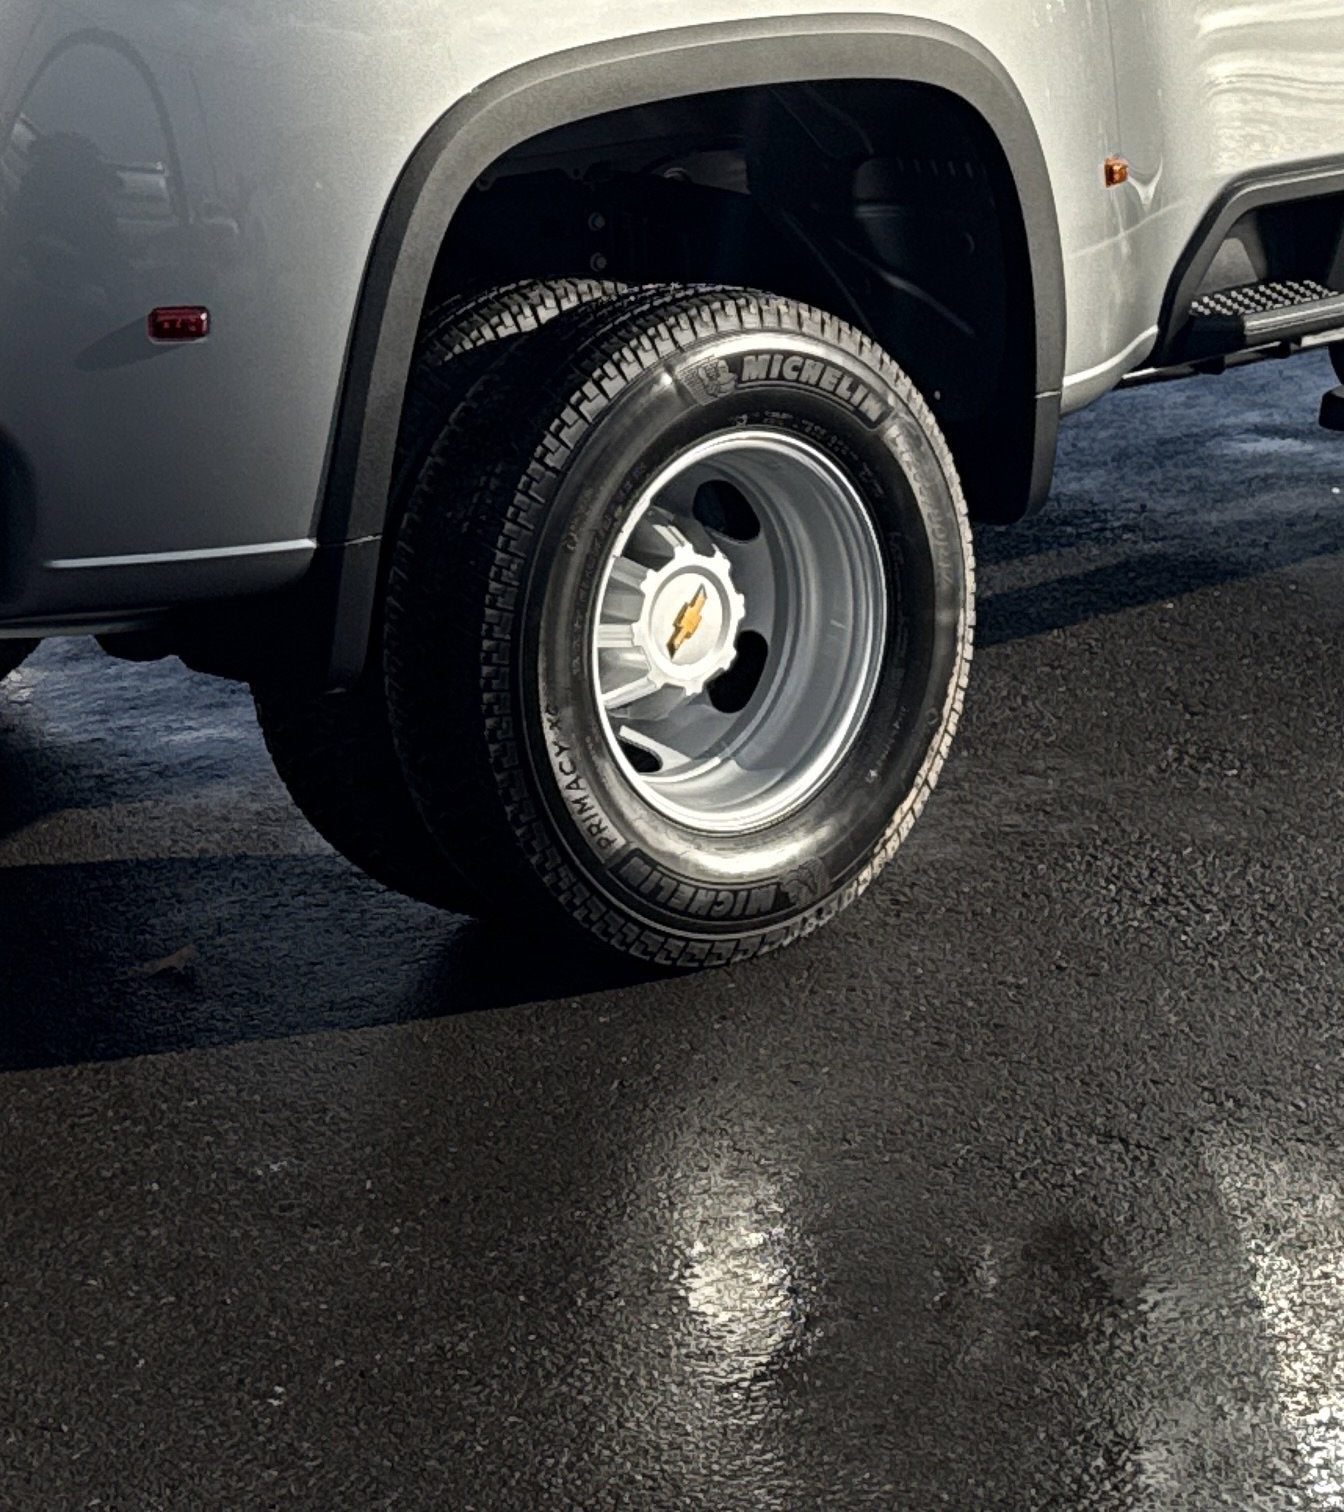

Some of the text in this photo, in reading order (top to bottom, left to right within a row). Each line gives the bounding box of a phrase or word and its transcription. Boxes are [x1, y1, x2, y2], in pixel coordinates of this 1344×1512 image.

[742, 354, 886, 423] MICHELIN
[552, 740, 618, 849] PRIMACY
[619, 856, 779, 918] MICHELIN
